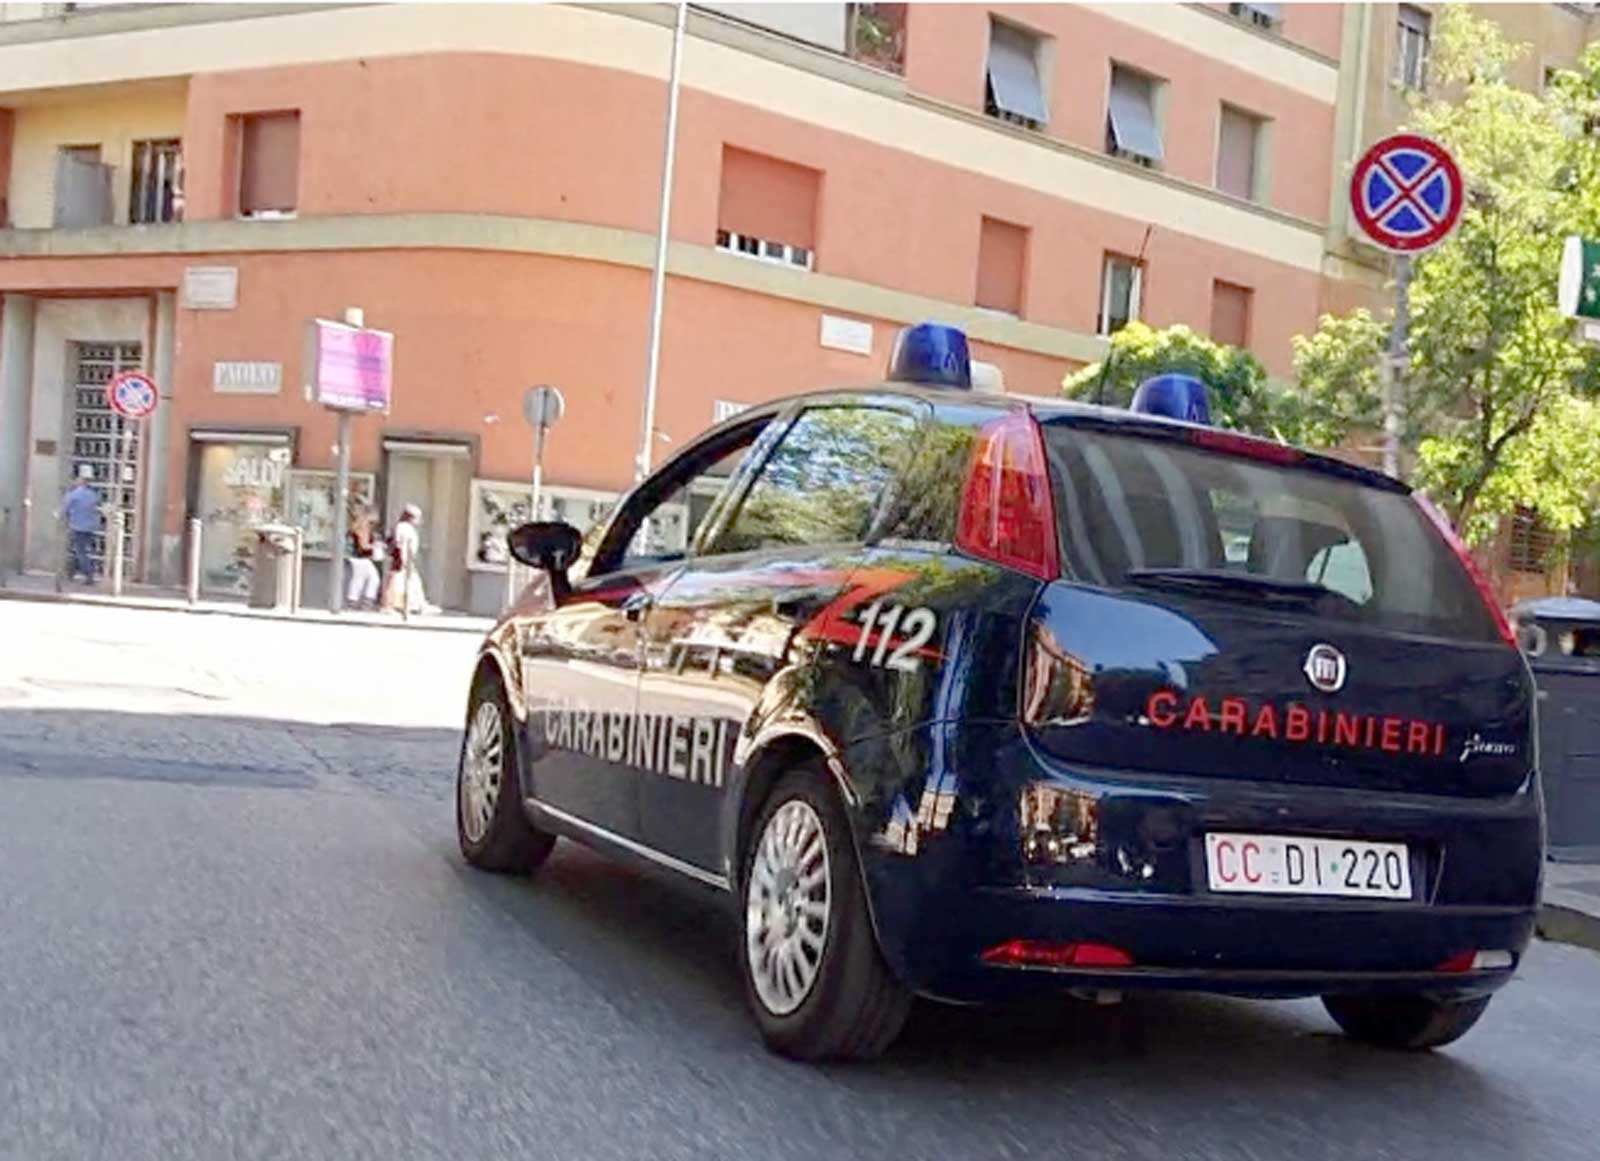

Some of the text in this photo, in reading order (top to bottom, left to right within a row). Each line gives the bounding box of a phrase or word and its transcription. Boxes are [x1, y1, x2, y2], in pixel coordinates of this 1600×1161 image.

[853, 600, 937, 672] 112
[544, 705, 728, 787] CARABINIERI
[1147, 690, 1447, 756] CARABINIERI
[1217, 841, 1402, 890] CC DI 220
